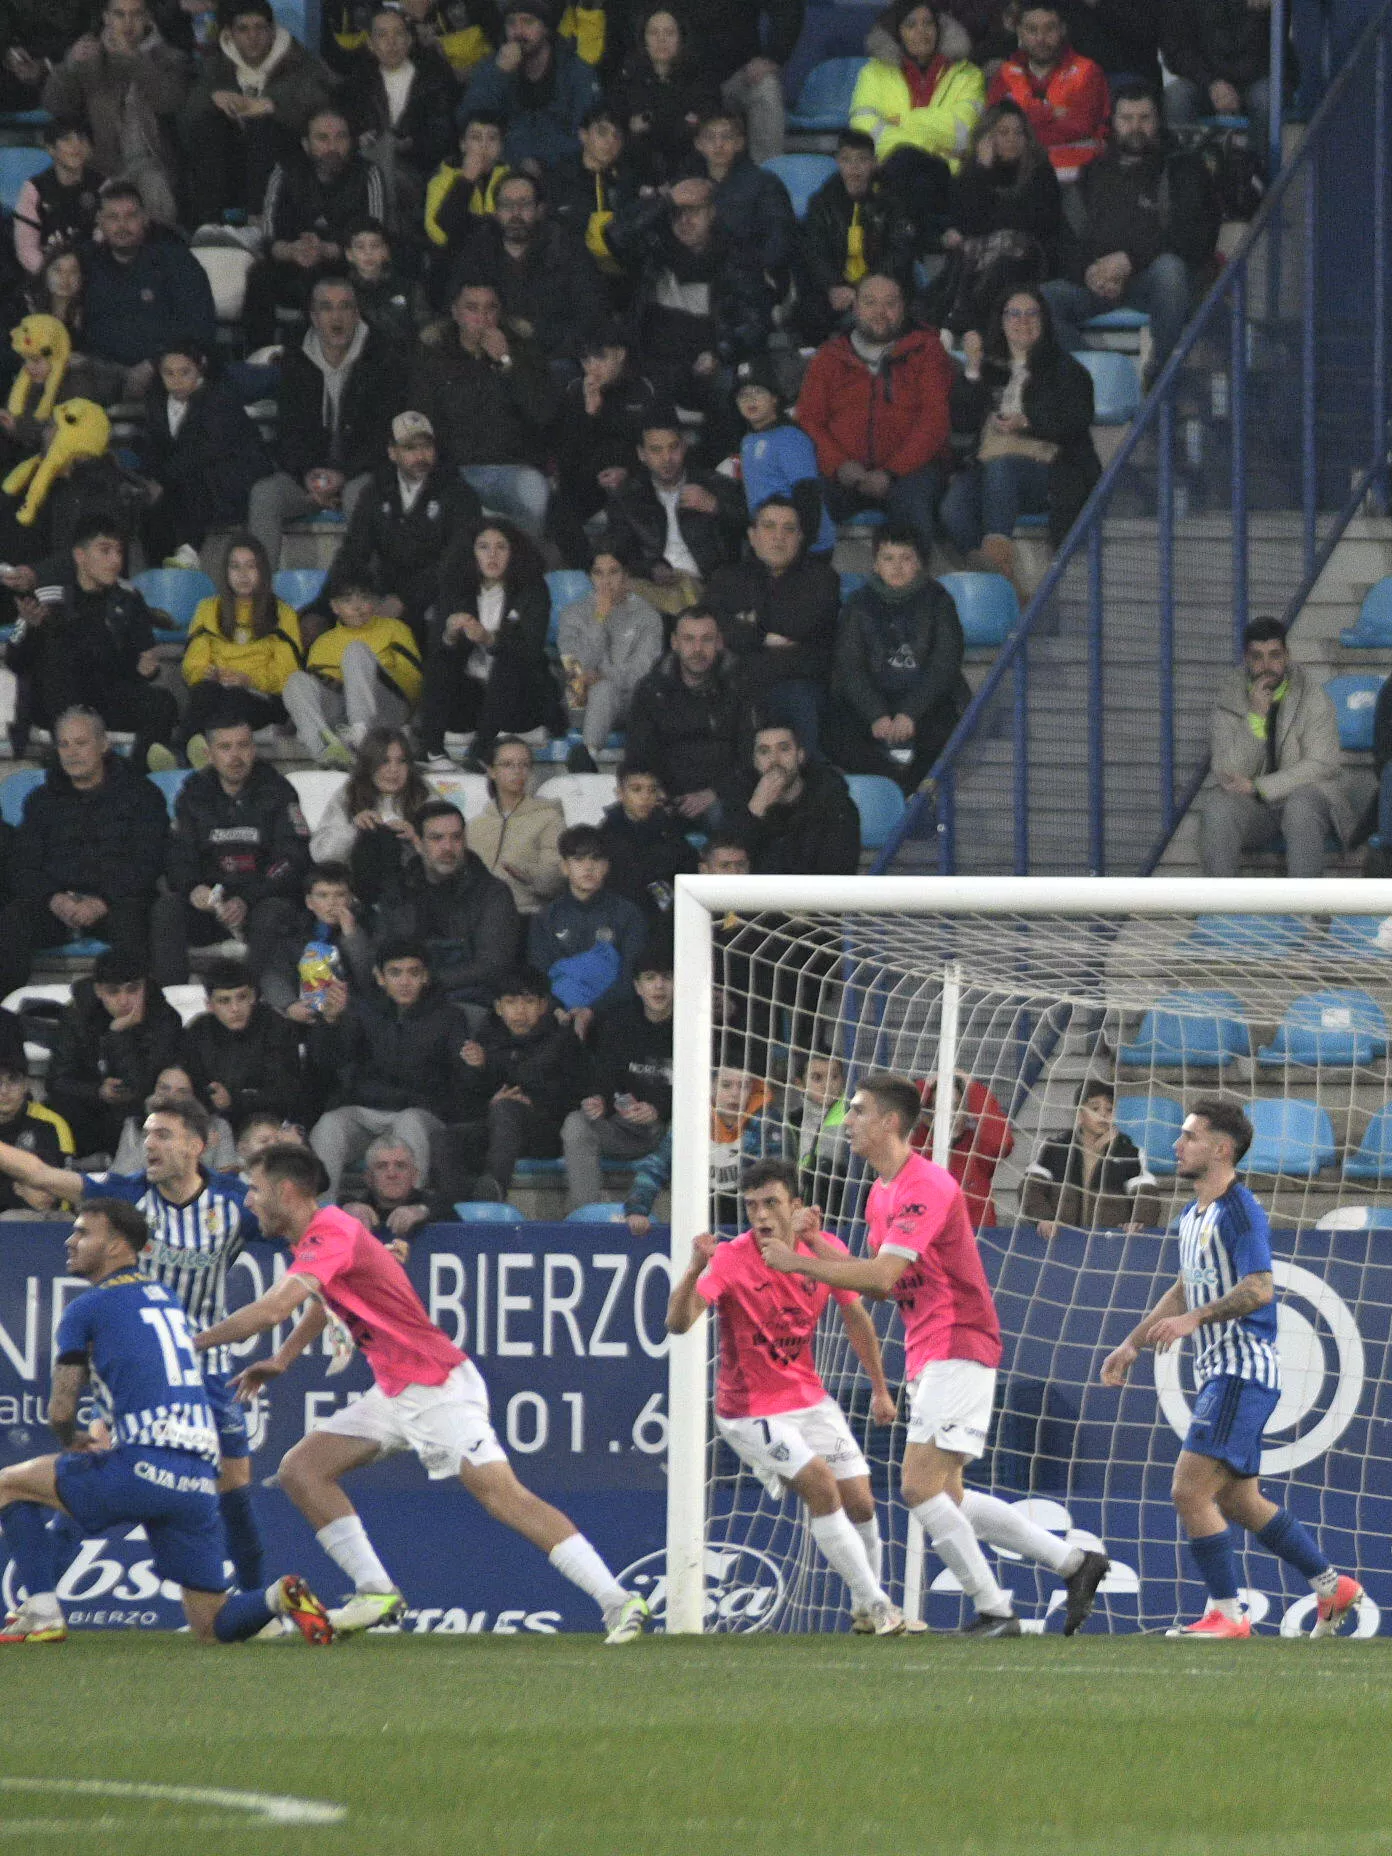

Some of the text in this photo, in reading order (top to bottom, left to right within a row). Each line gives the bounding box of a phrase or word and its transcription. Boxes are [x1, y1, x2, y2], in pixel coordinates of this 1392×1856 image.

[429, 1253, 669, 1359] BIERZO
[139, 1307, 203, 1387] 15
[752, 1418, 772, 1445] 7
[133, 1460, 175, 1490] CAJA
[68, 1610, 158, 1626] BIERZO
